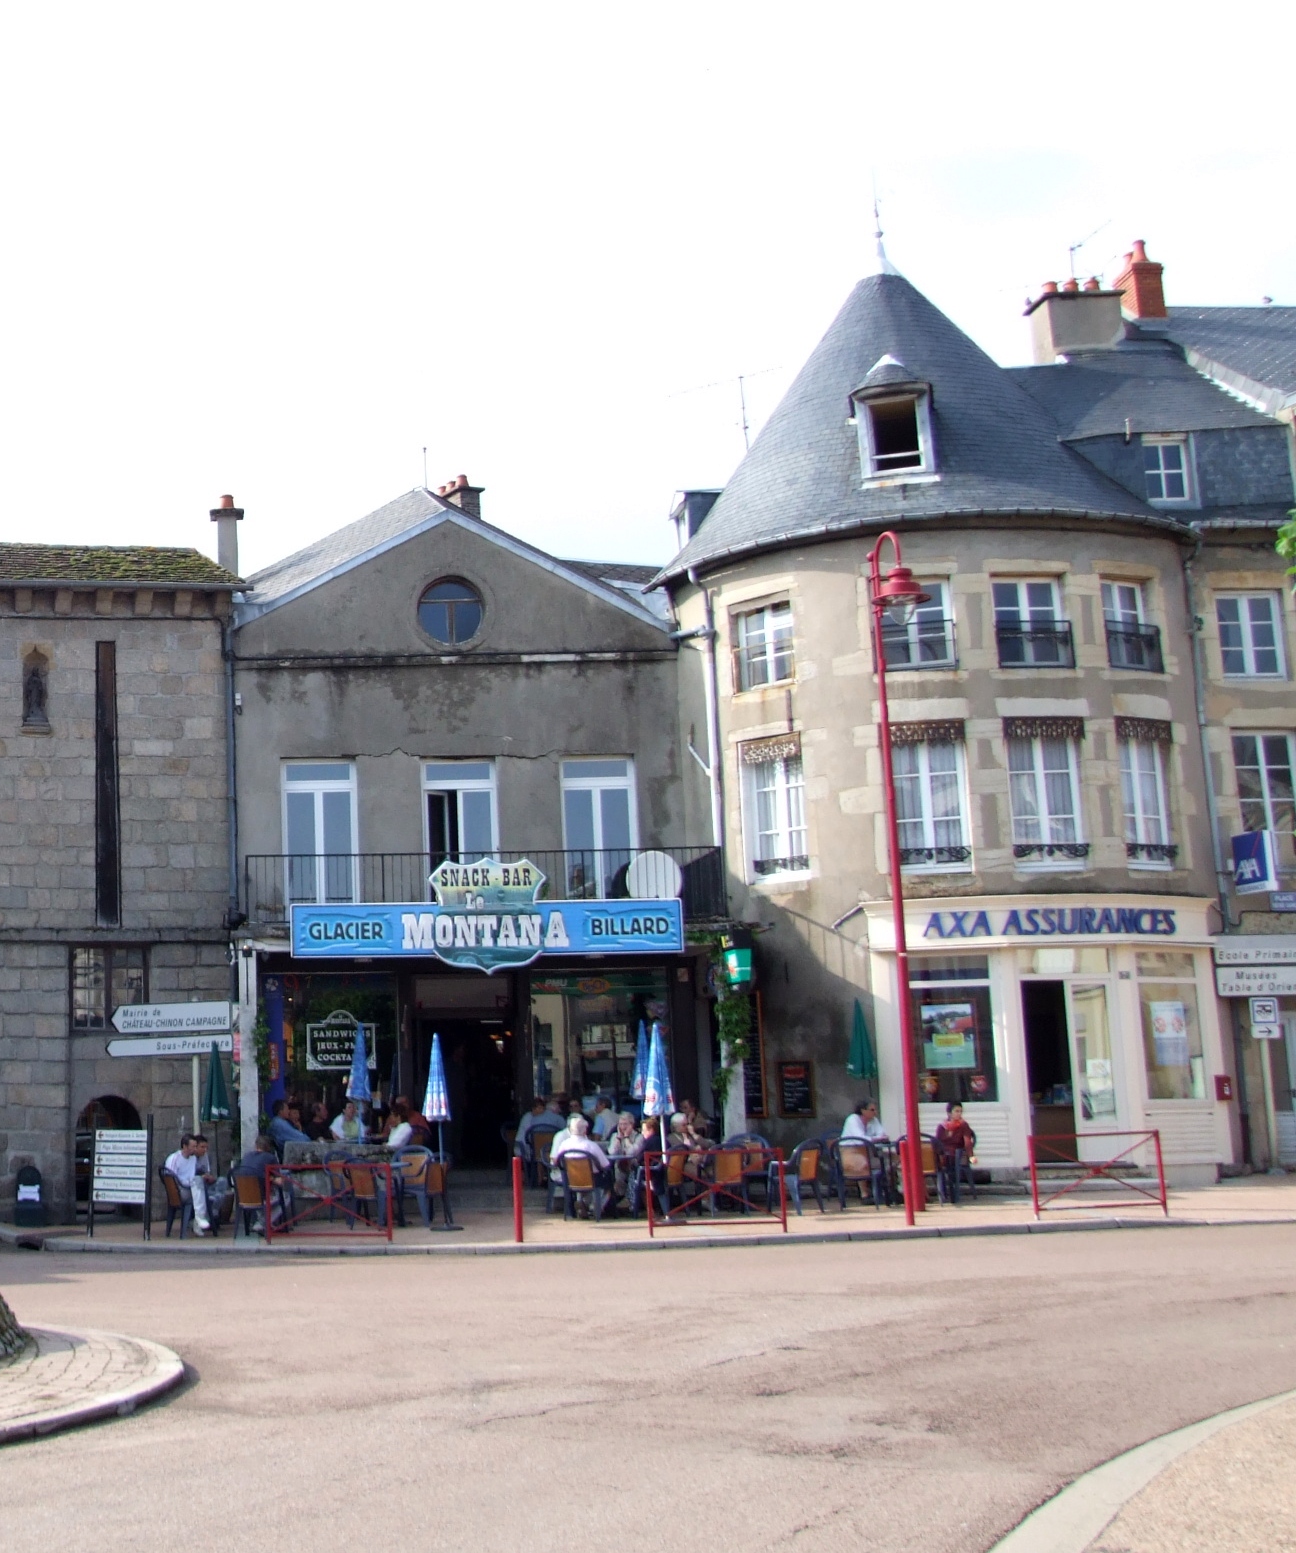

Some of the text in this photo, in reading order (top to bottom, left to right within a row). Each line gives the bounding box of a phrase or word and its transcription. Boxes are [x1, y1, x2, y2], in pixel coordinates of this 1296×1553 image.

[441, 868, 490, 886] SNACK
[502, 867, 533, 886] BAR
[1233, 858, 1260, 881] AXA
[465, 892, 484, 909] Le
[402, 911, 569, 949] MONTANA
[591, 916, 670, 937] BILLARD
[923, 907, 1177, 938] AXA ASSURANCES
[308, 921, 384, 941] GLACIER
[1218, 950, 1249, 960] Ecole
[1235, 971, 1277, 980] Musées
[1221, 983, 1252, 992] Table
[122, 1008, 161, 1018] Mairie de
[122, 1016, 227, 1029] CHÂTEAU-CHINON CAMPAGNE
[313, 1030, 371, 1038] SANDWICS
[317, 1053, 354, 1062] COCKTA
